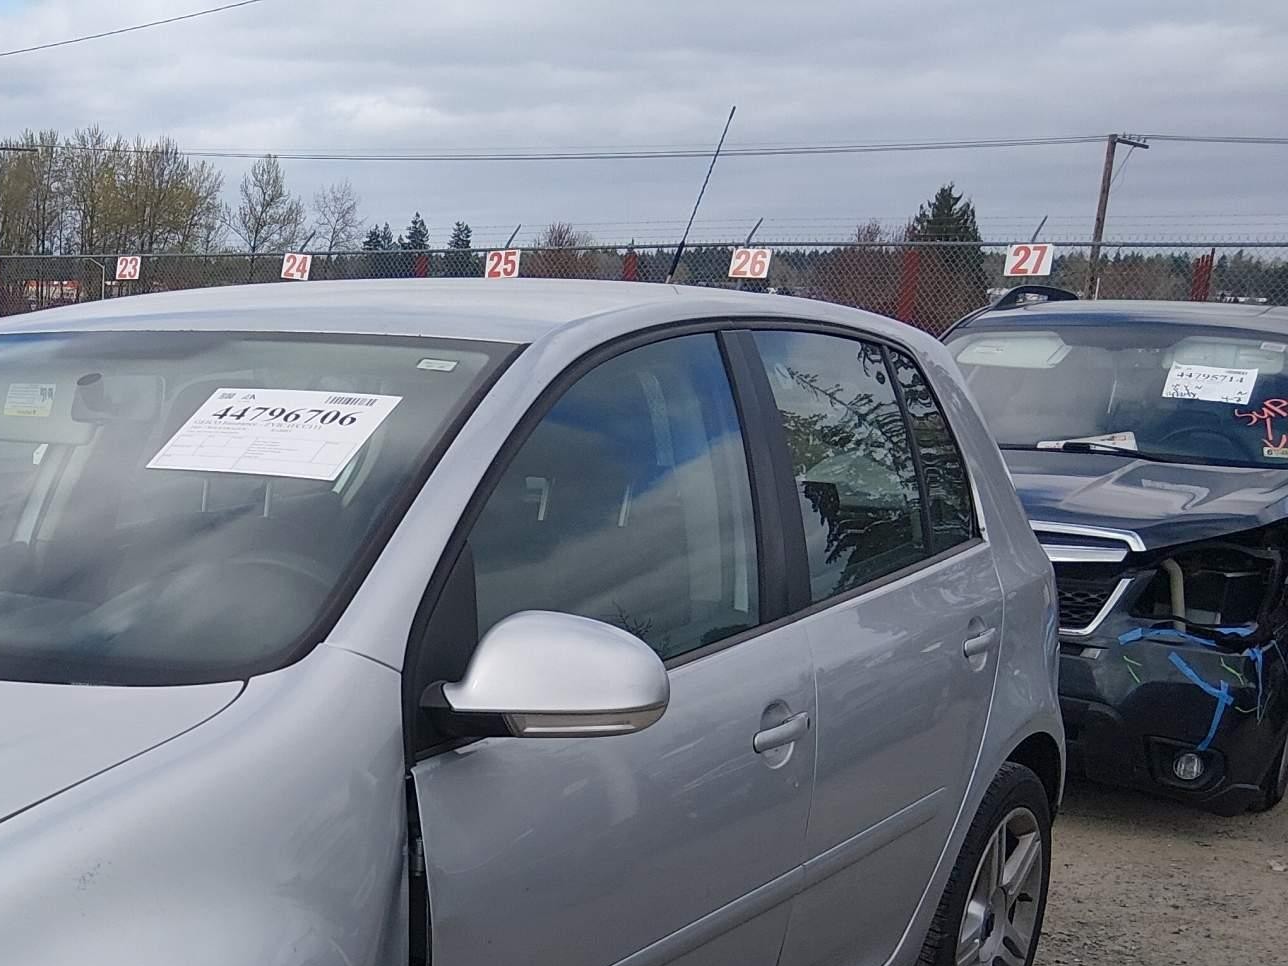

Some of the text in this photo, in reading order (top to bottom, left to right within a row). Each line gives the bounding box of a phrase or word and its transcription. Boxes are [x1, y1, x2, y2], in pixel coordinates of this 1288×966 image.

[118, 257, 138, 279] 23
[285, 255, 308, 277] 24
[487, 252, 517, 278] 25
[732, 250, 767, 276] 26
[1011, 246, 1048, 275] 27
[211, 405, 363, 426] 44796706
